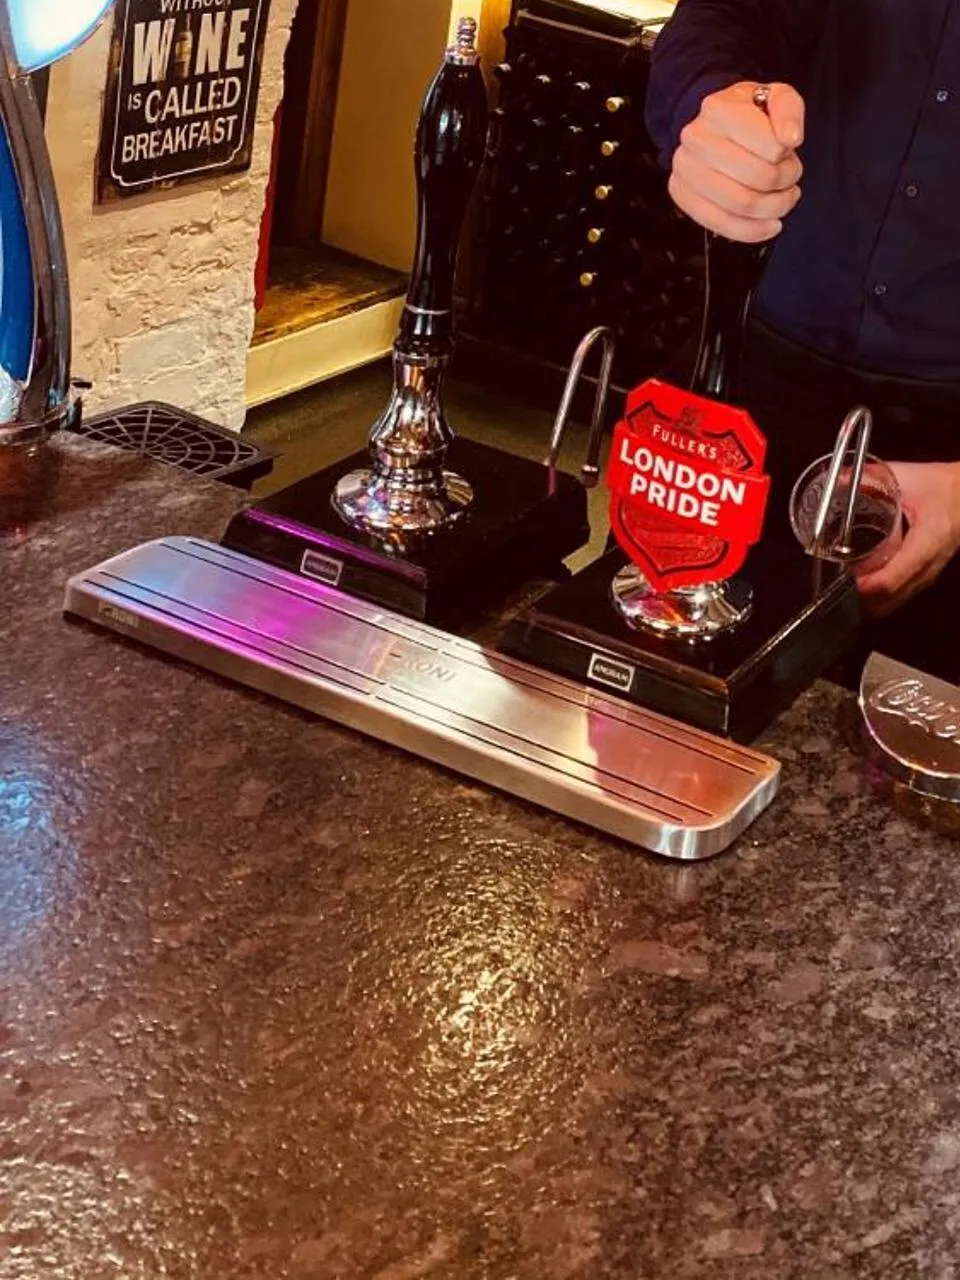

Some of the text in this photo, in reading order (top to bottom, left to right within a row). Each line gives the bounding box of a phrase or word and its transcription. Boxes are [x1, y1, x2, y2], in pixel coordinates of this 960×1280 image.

[127, 75, 242, 124] IS CALLED
[121, 114, 239, 164] BREAKFAST
[652, 423, 718, 461] FULLER'S
[619, 437, 747, 506] LONDON
[630, 472, 721, 527] PRIDE
